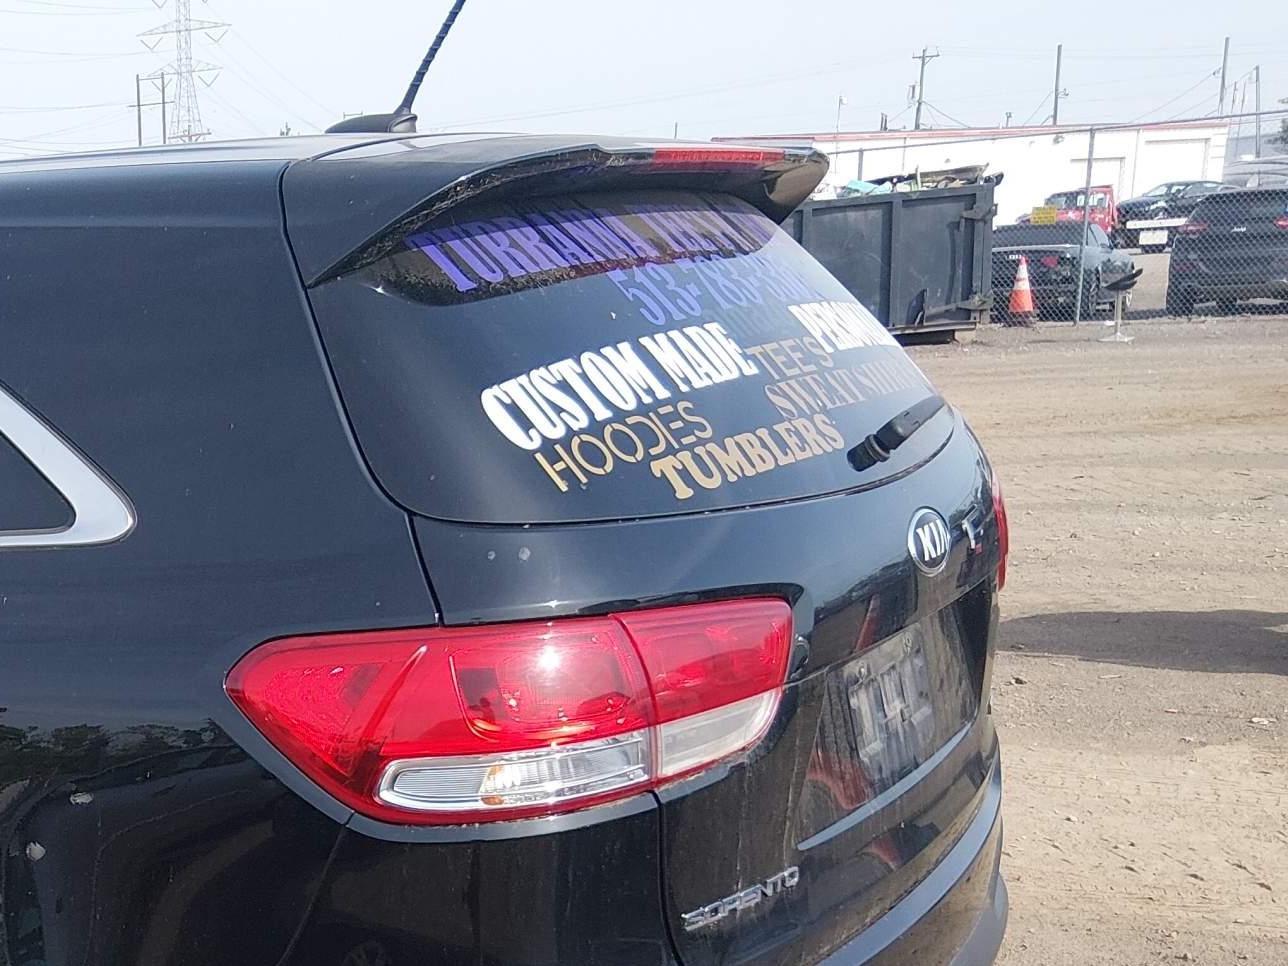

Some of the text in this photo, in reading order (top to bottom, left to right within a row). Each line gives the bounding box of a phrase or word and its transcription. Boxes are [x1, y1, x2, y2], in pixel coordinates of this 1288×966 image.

[405, 208, 658, 292] TURRANNA
[481, 342, 671, 450] CUSTOM
[638, 322, 759, 392] MADE
[744, 336, 834, 380] TEE'S
[534, 401, 712, 492] HOODIES
[650, 414, 844, 499] TUMBLERS
[915, 518, 951, 561] KIA
